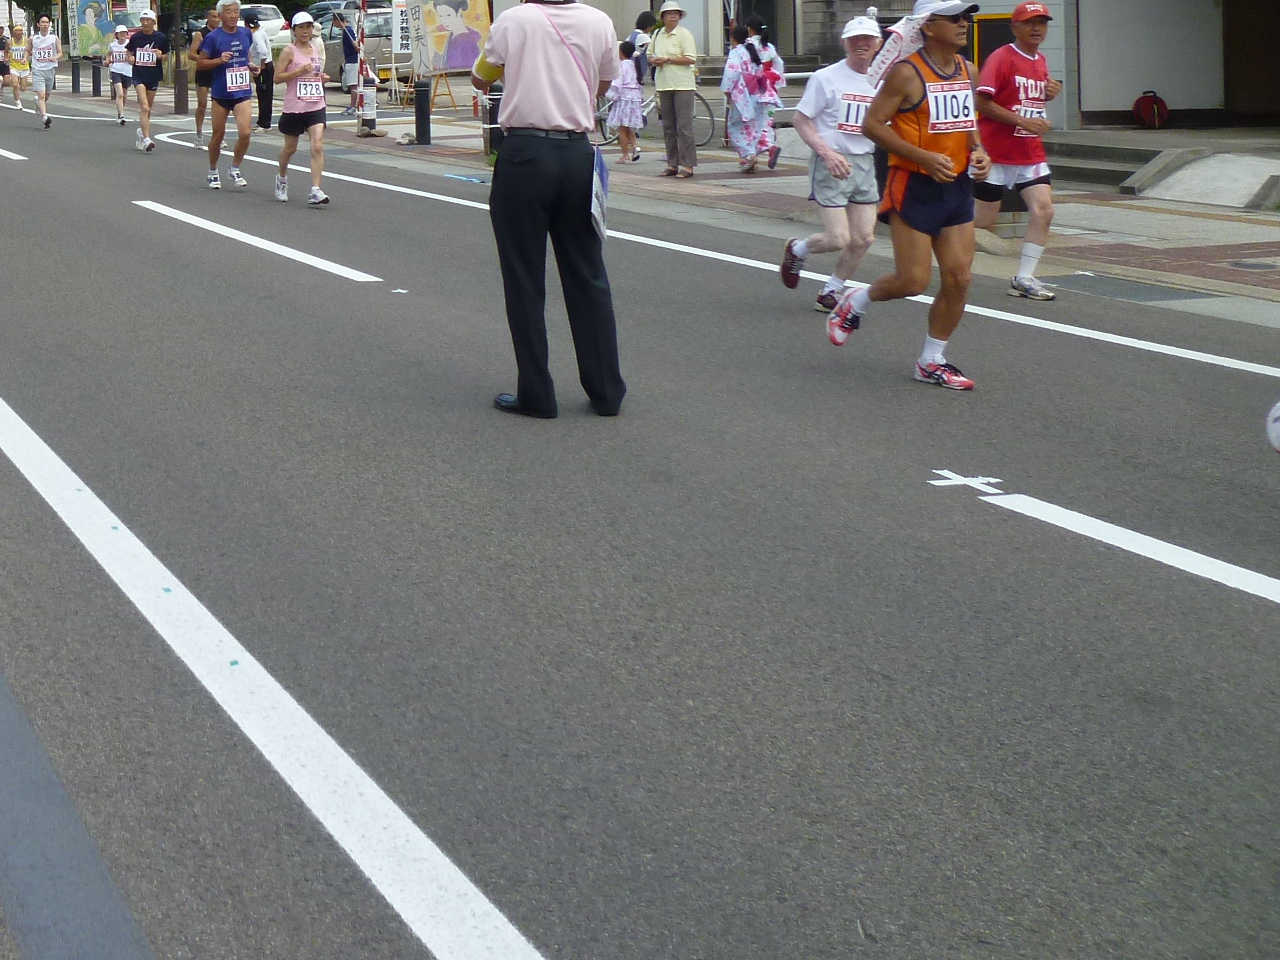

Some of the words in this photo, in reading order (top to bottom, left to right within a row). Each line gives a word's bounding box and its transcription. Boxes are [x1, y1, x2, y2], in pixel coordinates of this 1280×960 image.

[399, 9, 411, 51] 松井整骨院
[139, 52, 154, 62] 1131
[230, 72, 247, 86] 1191
[298, 82, 322, 96] 1328
[933, 93, 971, 121] 1106
